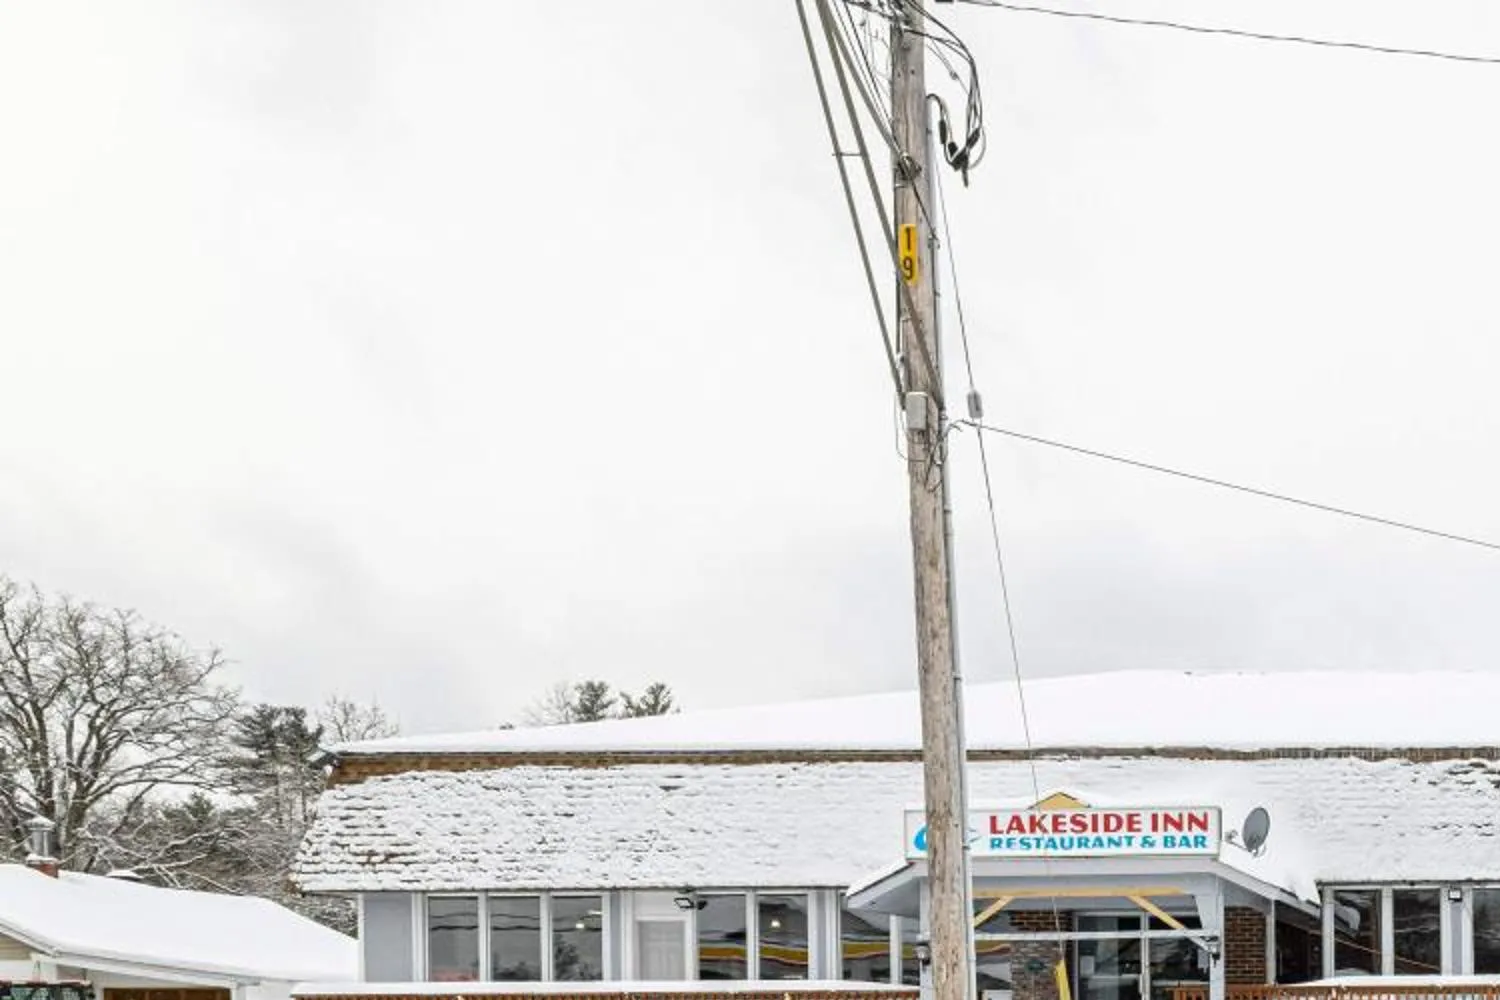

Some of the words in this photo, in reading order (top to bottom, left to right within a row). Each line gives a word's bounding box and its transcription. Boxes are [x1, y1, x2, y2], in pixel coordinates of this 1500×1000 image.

[989, 813, 1142, 834] LAKESIDE
[1151, 812, 1208, 832] INN
[990, 835, 1136, 850] RESTAURANT
[1140, 835, 1157, 848] &
[1163, 835, 1207, 848] BAR
